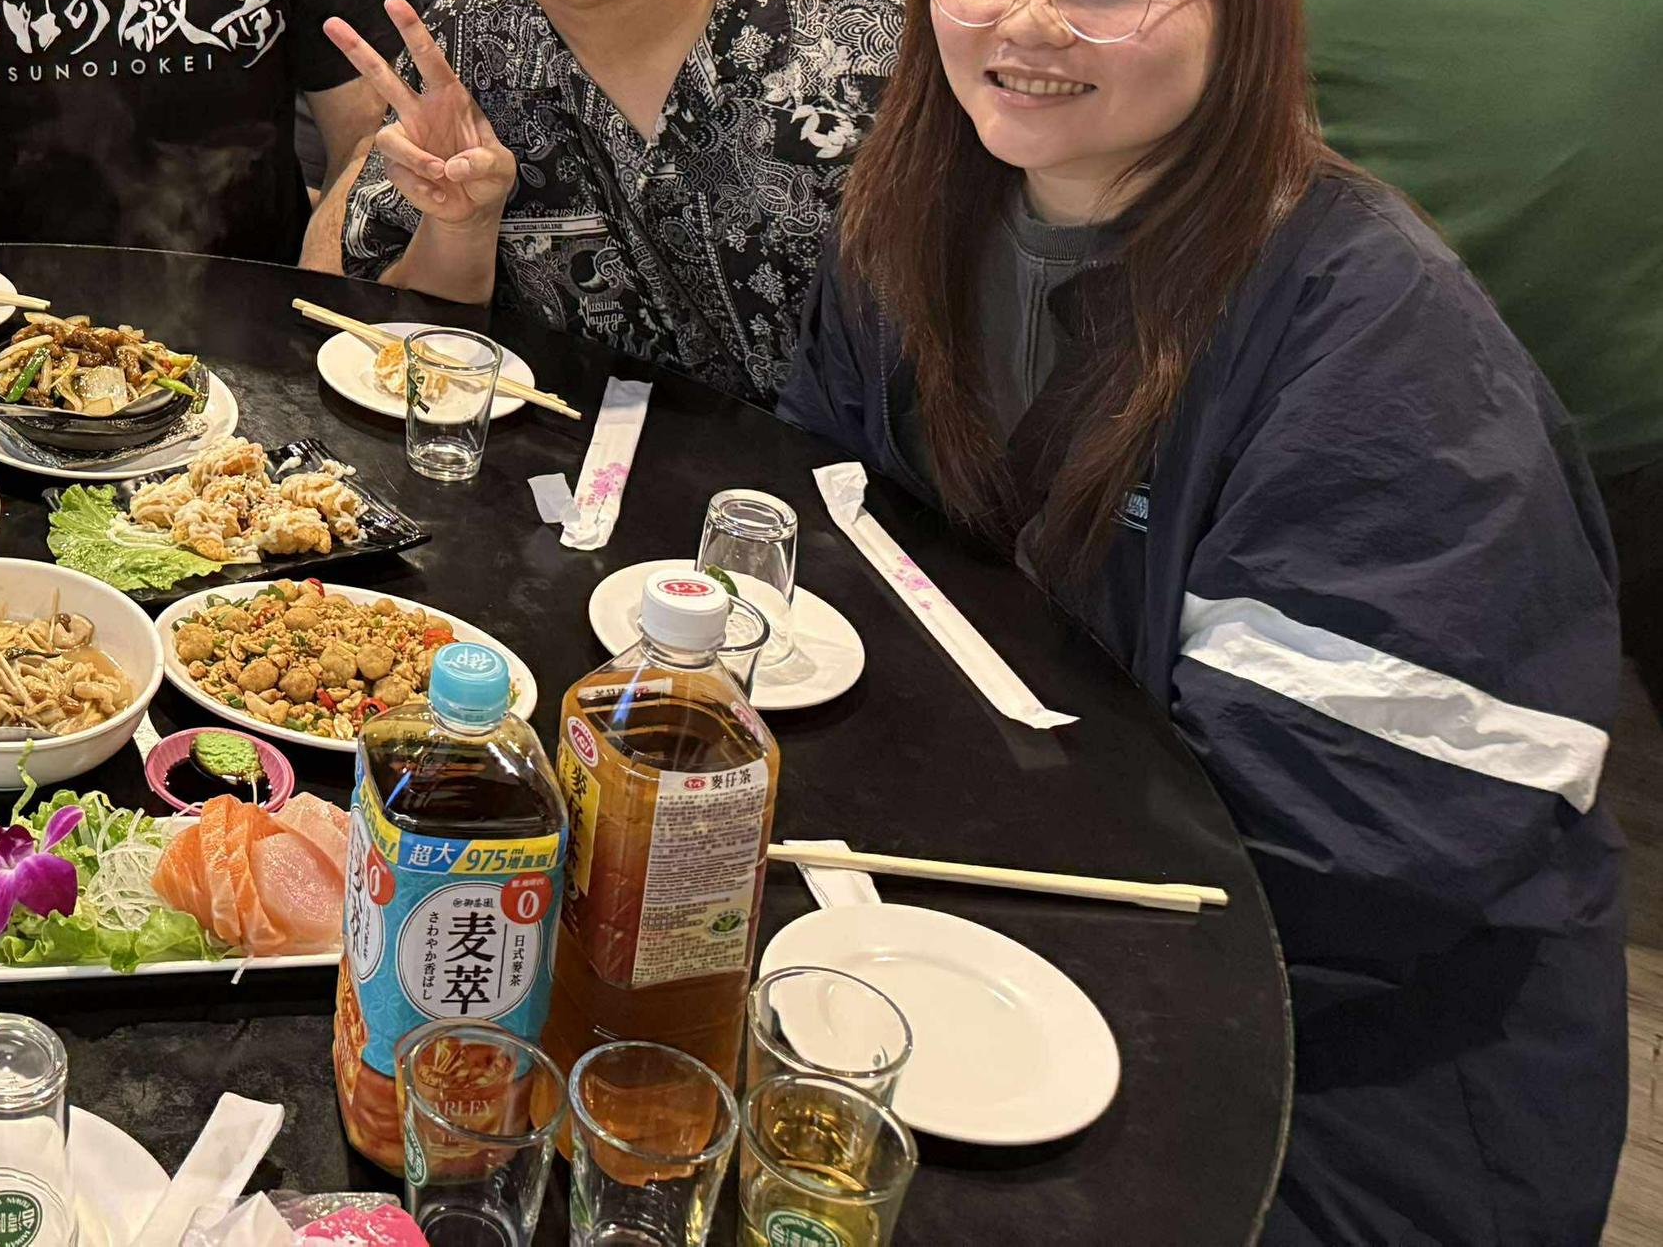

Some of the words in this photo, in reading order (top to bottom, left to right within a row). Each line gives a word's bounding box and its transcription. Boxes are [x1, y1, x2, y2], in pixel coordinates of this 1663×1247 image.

[711, 767, 752, 791] 麥仔茶
[407, 842, 457, 867] 超大
[465, 849, 508, 872] 975
[369, 865, 380, 897] 0
[517, 890, 540, 919] 0
[423, 911, 440, 1001] さわやか香ばし
[440, 911, 497, 1015] 麦萃
[509, 934, 526, 987] 日式麥茶
